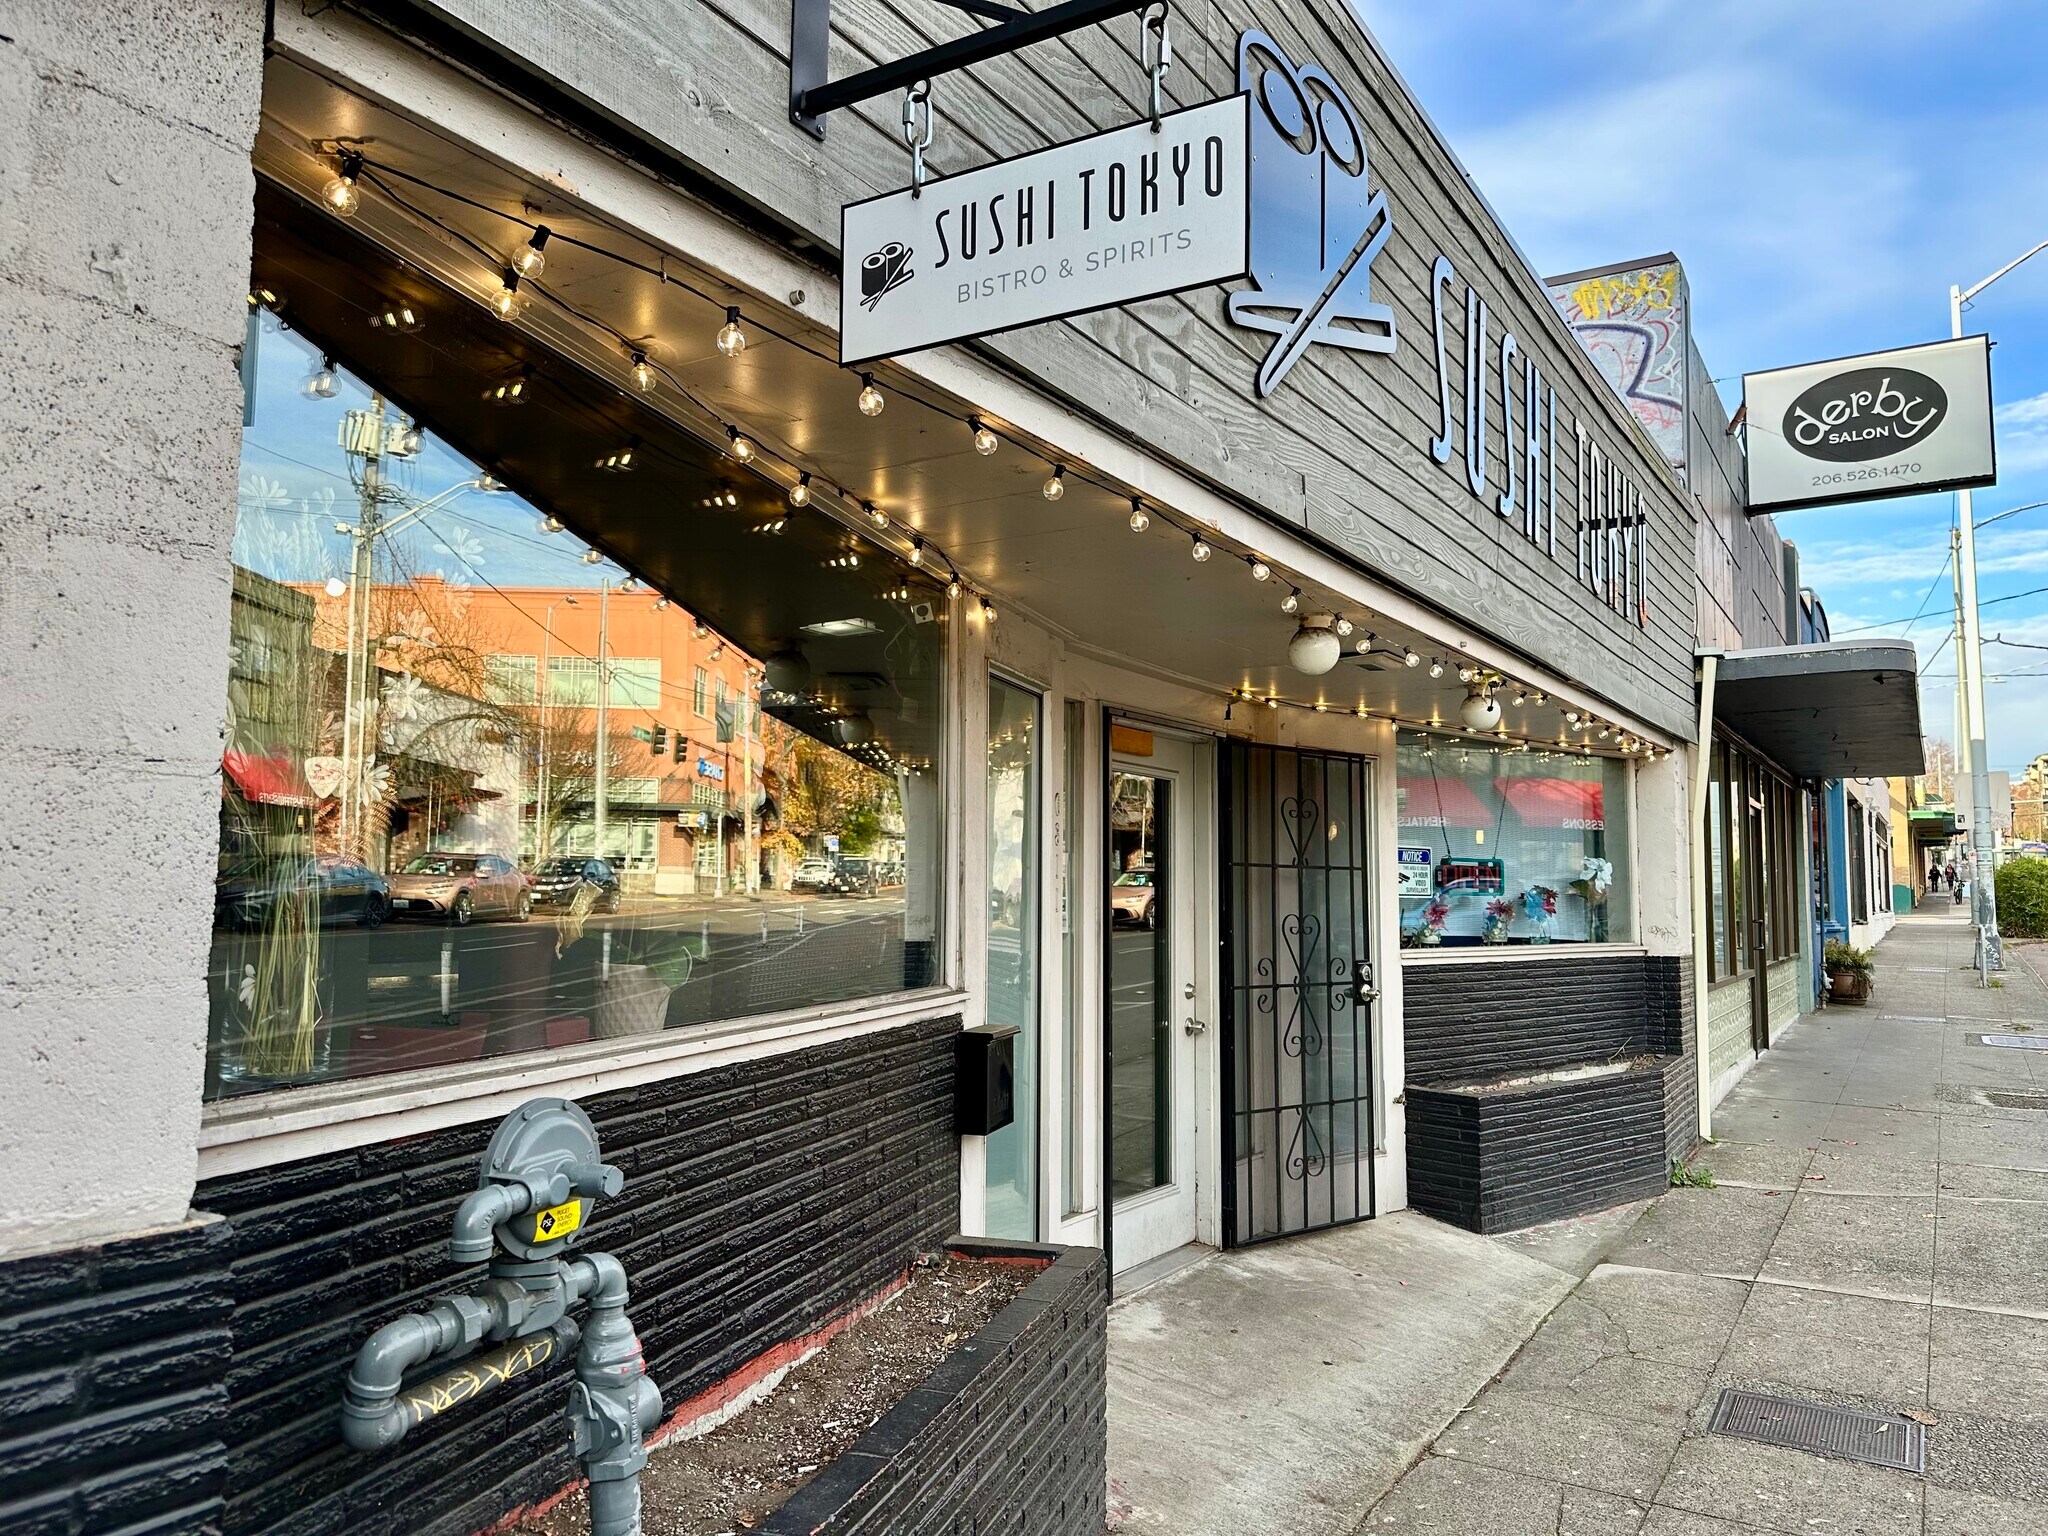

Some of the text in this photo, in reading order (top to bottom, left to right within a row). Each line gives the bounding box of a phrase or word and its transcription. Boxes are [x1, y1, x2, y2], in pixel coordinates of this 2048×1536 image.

[934, 135, 1224, 269] SUSHI TOKYO
[957, 228, 1192, 304] BISTRO & SPIRITS
[1793, 377, 1938, 446] derby
[1430, 255, 1647, 629] SUSHI TOKYO
[1828, 425, 1889, 444] SALON
[1811, 462, 1922, 487] 206.526.1470
[1402, 851, 1423, 862] NOTICE
[1443, 865, 1499, 889] OPEN
[542, 1217, 553, 1228] PSE
